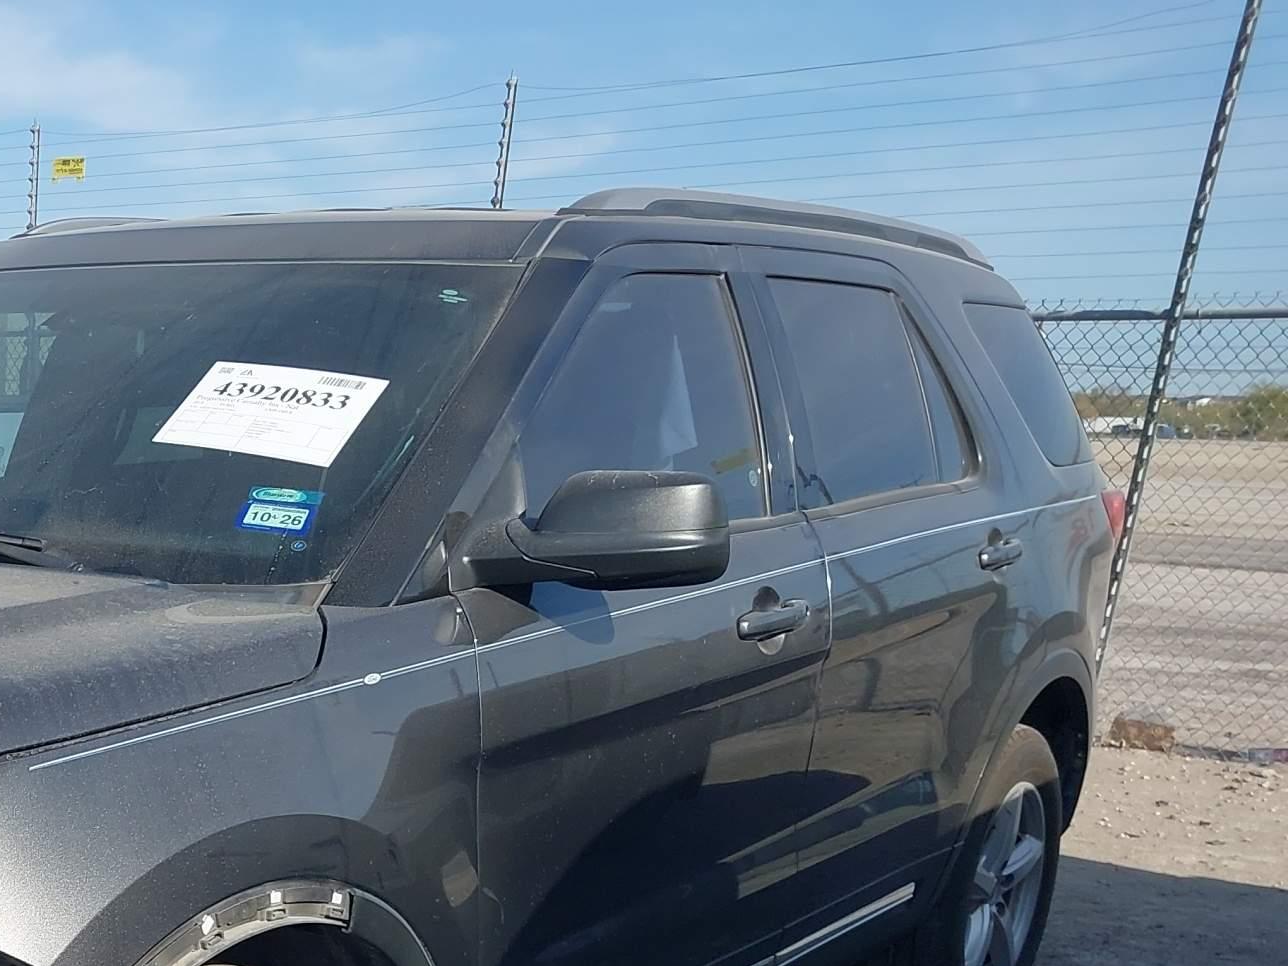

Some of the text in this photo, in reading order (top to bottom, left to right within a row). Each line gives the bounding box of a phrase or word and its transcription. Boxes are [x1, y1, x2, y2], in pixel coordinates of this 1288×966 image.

[213, 381, 351, 410] 43920833
[250, 511, 304, 526] 10 26
